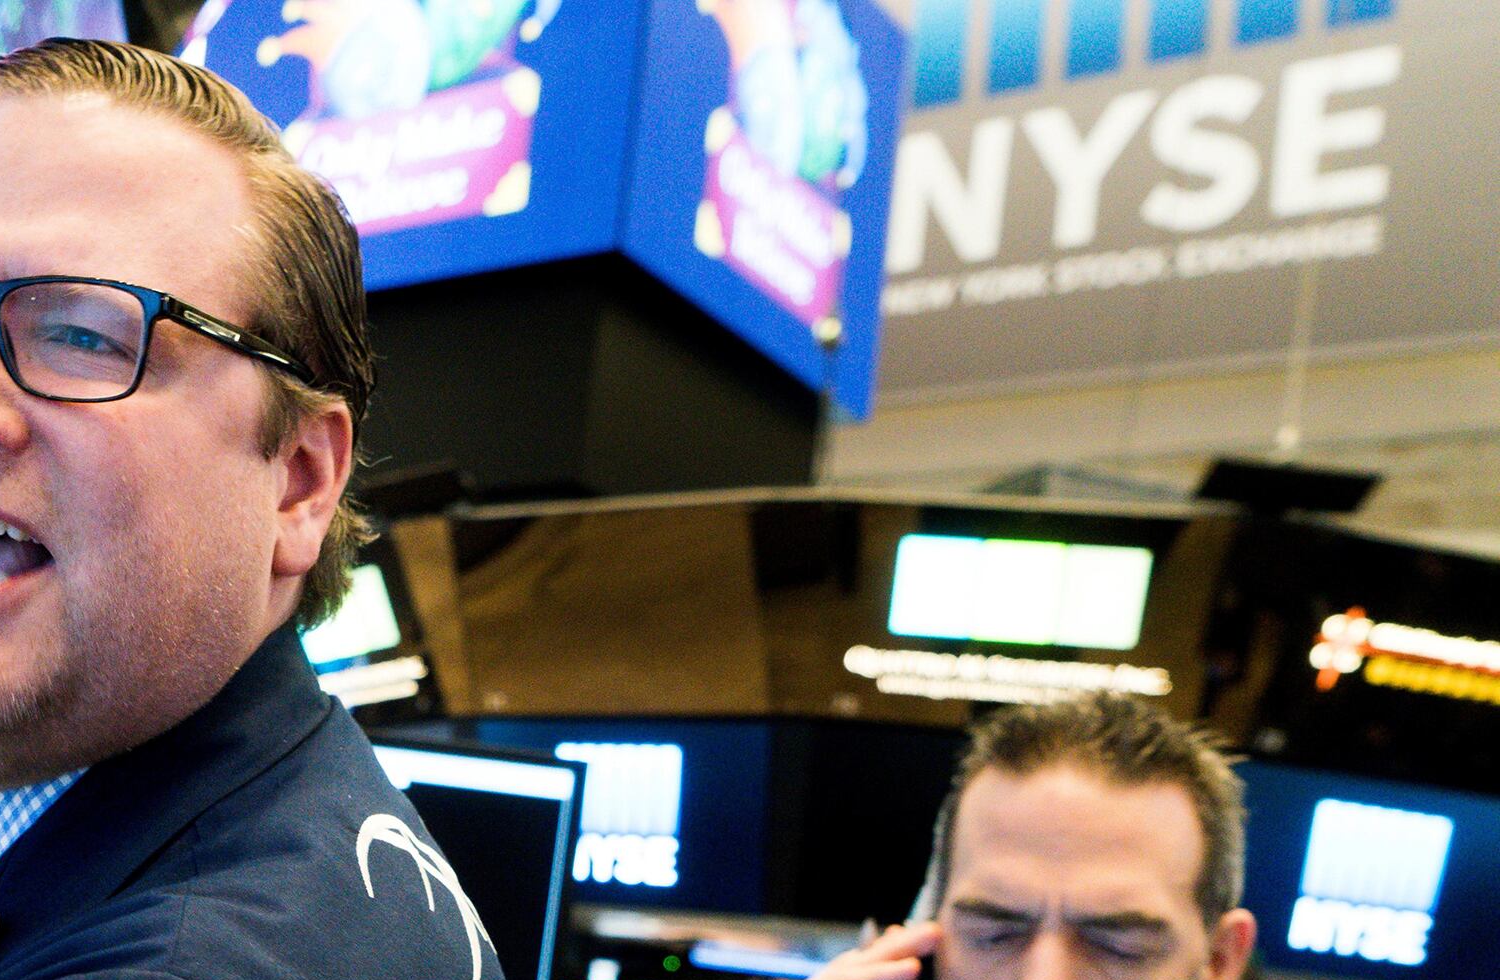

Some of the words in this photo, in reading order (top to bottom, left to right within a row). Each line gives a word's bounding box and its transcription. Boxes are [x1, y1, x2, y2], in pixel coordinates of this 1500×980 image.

[883, 43, 1403, 275] NYSE
[958, 263, 1049, 304] YORK
[1051, 246, 1166, 294] STOCK
[1172, 215, 1384, 279] EXCHANGE
[1287, 896, 1434, 966] NYSE
